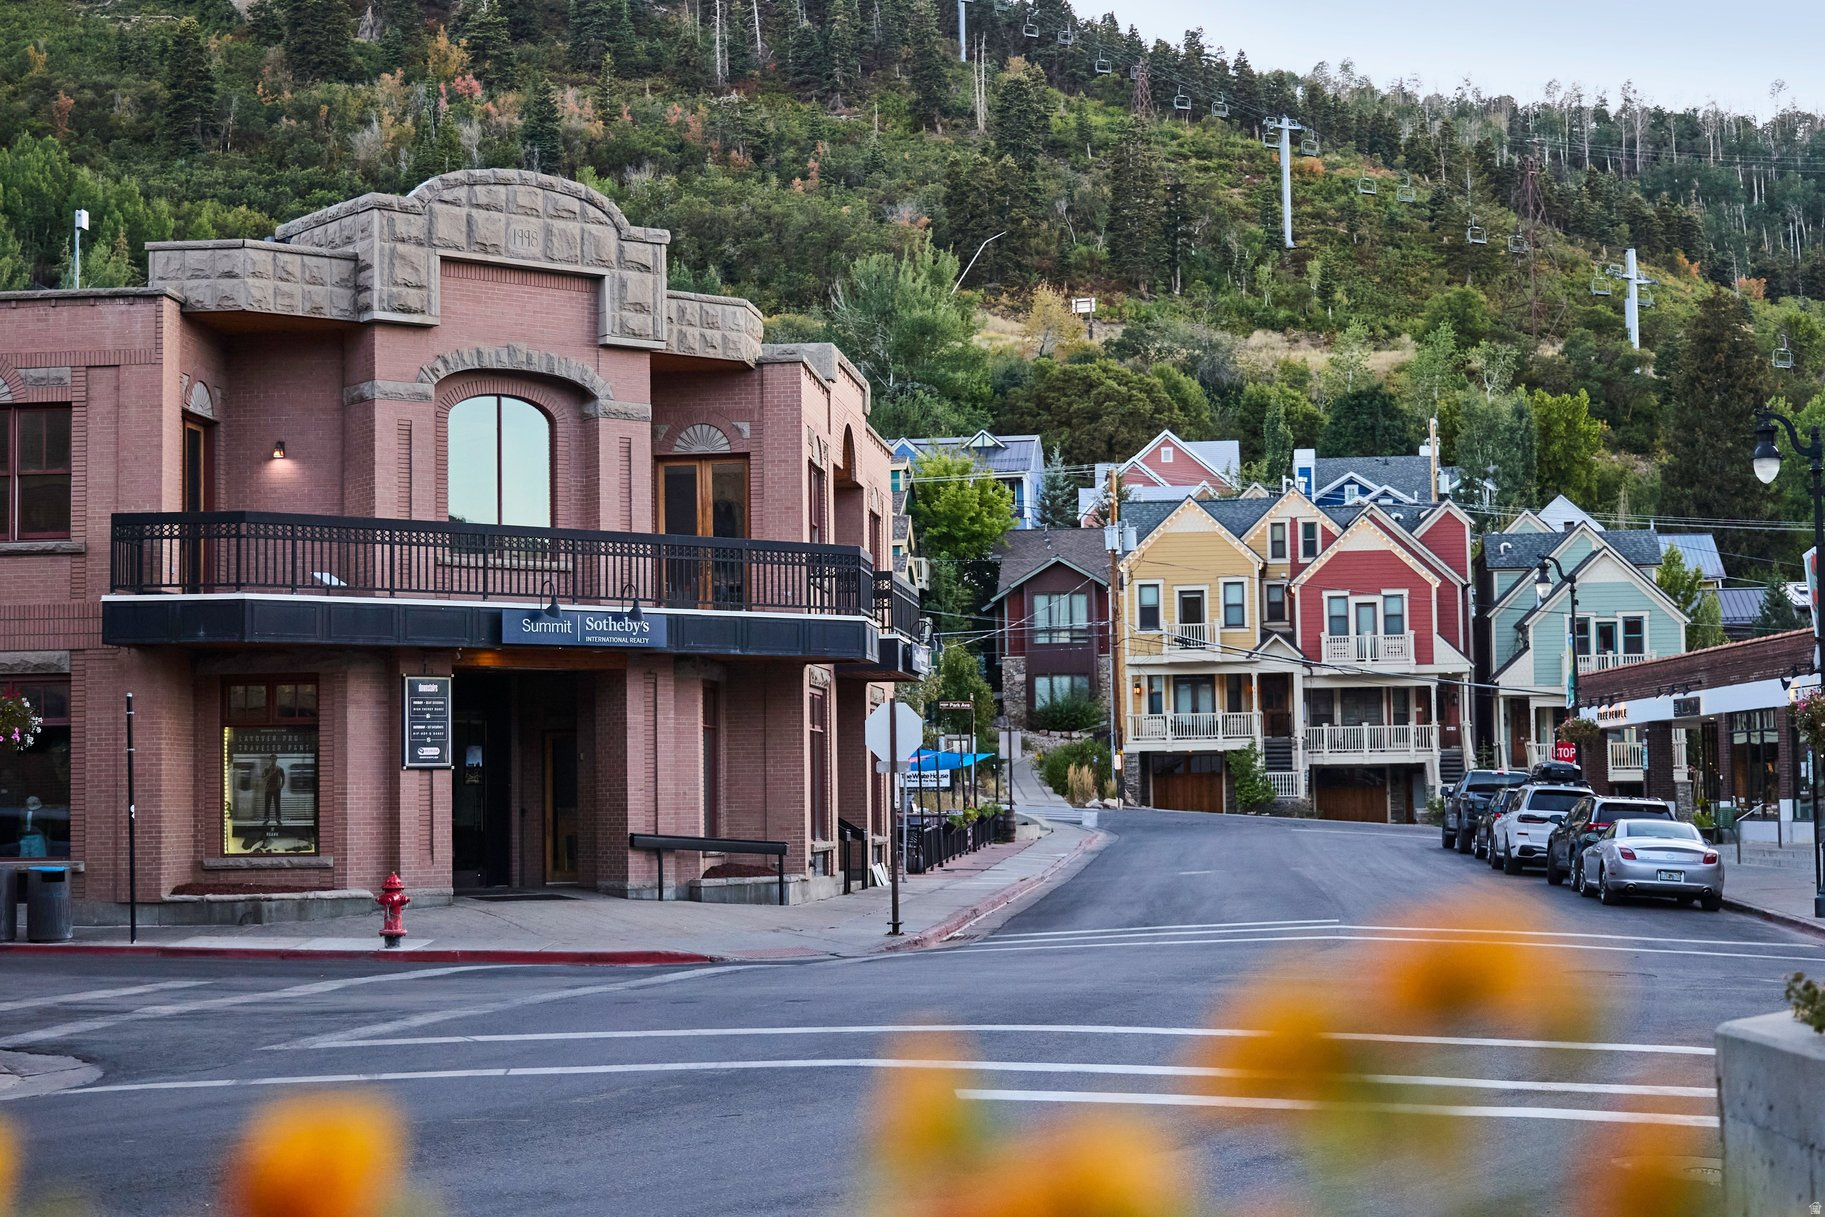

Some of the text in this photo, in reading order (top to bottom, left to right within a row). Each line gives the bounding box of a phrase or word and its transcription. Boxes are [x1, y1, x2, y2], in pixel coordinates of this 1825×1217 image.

[513, 229, 538, 247] 1998
[522, 618, 572, 634] Summit
[585, 616, 650, 635] Sotheby's
[1597, 709, 1627, 721] FREE PEOPLE
